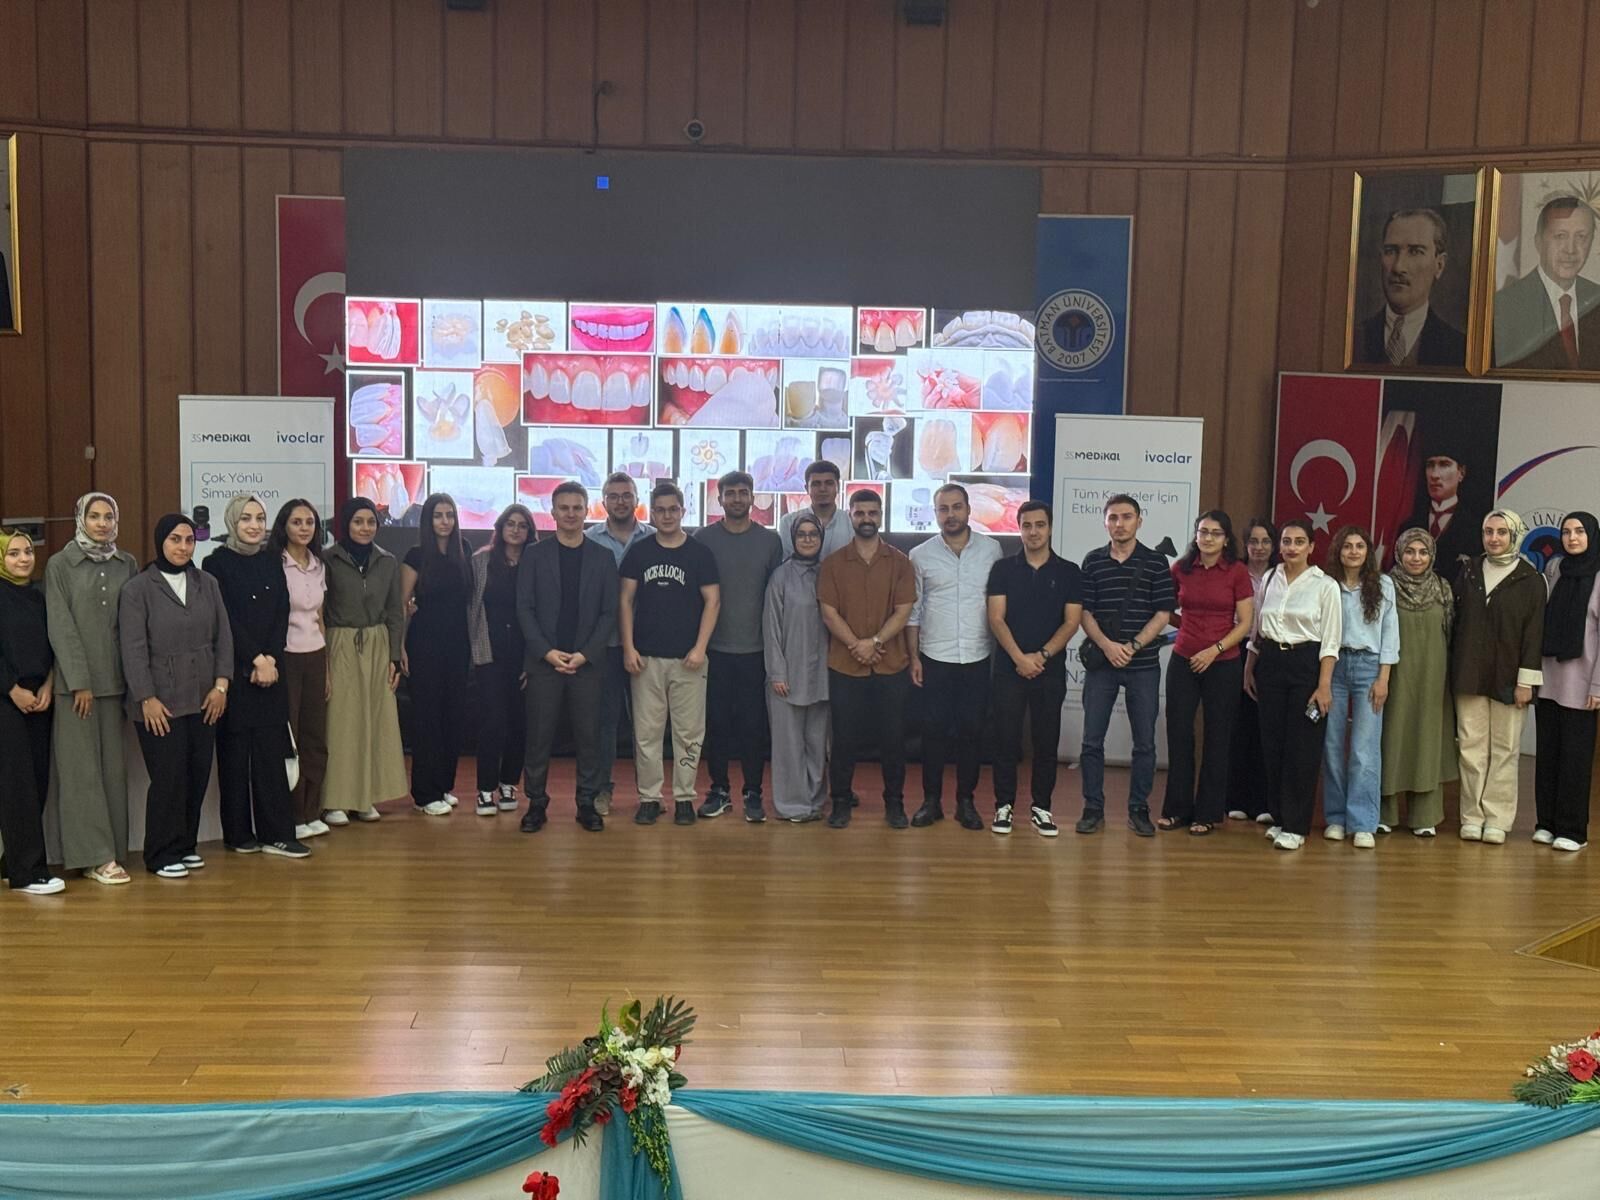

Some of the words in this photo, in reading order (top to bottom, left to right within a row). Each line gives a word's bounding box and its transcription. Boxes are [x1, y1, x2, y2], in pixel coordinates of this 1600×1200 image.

[1040, 303, 1060, 354] BATMAN
[1057, 352, 1086, 365] 2007
[276, 431, 325, 443] ivoclar
[1145, 450, 1192, 464] ivoclar
[201, 472, 225, 485] Çok
[228, 472, 263, 483] Yönlü
[201, 487, 279, 499] Simanyon
[1072, 488, 1099, 499] Tüm
[1102, 489, 1154, 502] Kaeler
[1071, 503, 1102, 514] Etkin
